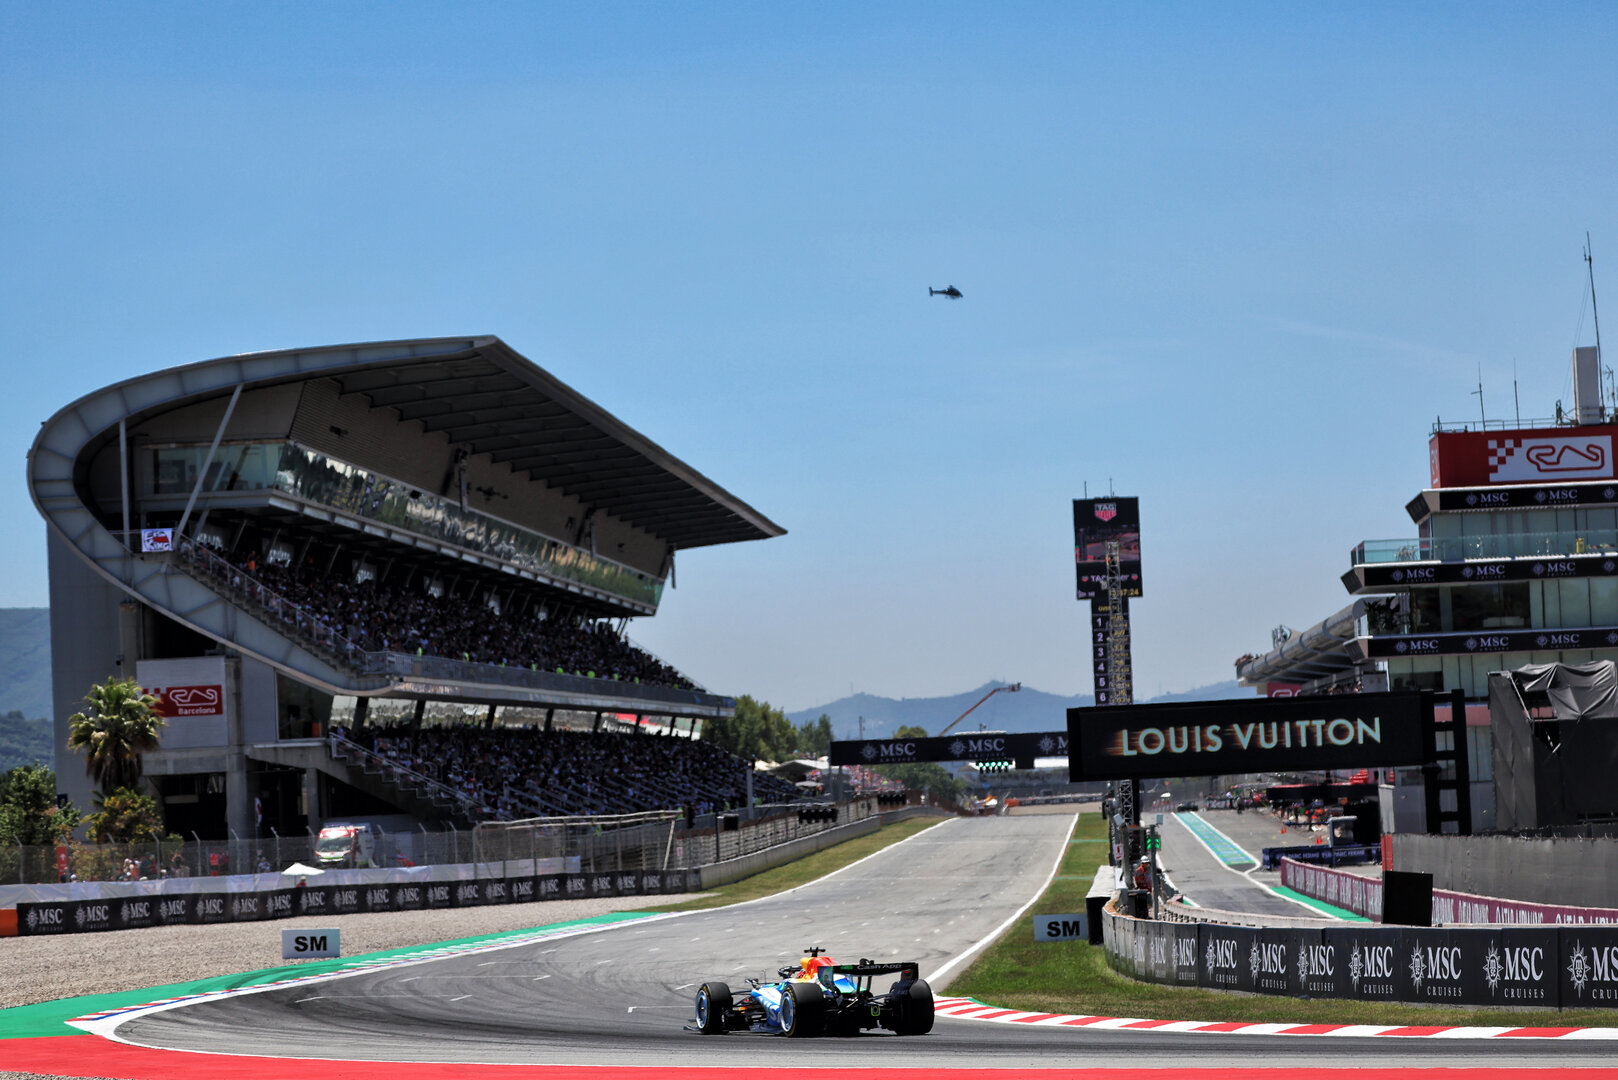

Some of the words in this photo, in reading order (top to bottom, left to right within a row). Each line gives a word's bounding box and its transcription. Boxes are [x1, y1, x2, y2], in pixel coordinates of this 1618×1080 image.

[1480, 492, 1509, 503] MSC
[1548, 489, 1578, 500] MSC
[1406, 568, 1435, 579] MSC
[1476, 565, 1505, 576] MSC
[1547, 562, 1576, 573] MSC
[1096, 617, 1102, 627] 1
[1097, 632, 1103, 642] 2
[1480, 636, 1509, 647] MSC
[1550, 634, 1580, 645] MSC
[1098, 647, 1104, 657] 3
[1409, 640, 1439, 650] MSC
[1098, 662, 1105, 671] 4
[1100, 692, 1106, 702] 6
[178, 707, 216, 715] Barcelona
[1122, 724, 1222, 756] LOUIS
[1232, 717, 1381, 750] VUITTON
[880, 742, 916, 757] MSC
[968, 738, 1005, 752] MSC
[241, 898, 258, 913] MSC
[274, 894, 292, 909] MSC
[308, 892, 326, 906] MSC
[130, 902, 150, 918] MSC
[168, 900, 186, 915] MSC
[205, 899, 223, 914] MSC
[38, 908, 63, 924] MSC
[86, 906, 109, 922] MSC
[1047, 920, 1080, 937] SM
[294, 936, 327, 952] SM
[1179, 938, 1196, 966] MSC
[1216, 939, 1237, 969] MSC
[1262, 943, 1286, 974] MSC
[1309, 945, 1334, 976] MSC
[1364, 946, 1393, 978] MSC
[1427, 947, 1462, 980] MSC
[1504, 947, 1543, 981] MSC
[1592, 946, 1618, 982] MS
[1364, 984, 1393, 994] CRUISES
[1427, 986, 1462, 996] CRUISES
[1504, 988, 1544, 998] CRUISES
[1592, 988, 1618, 999] CRUI
